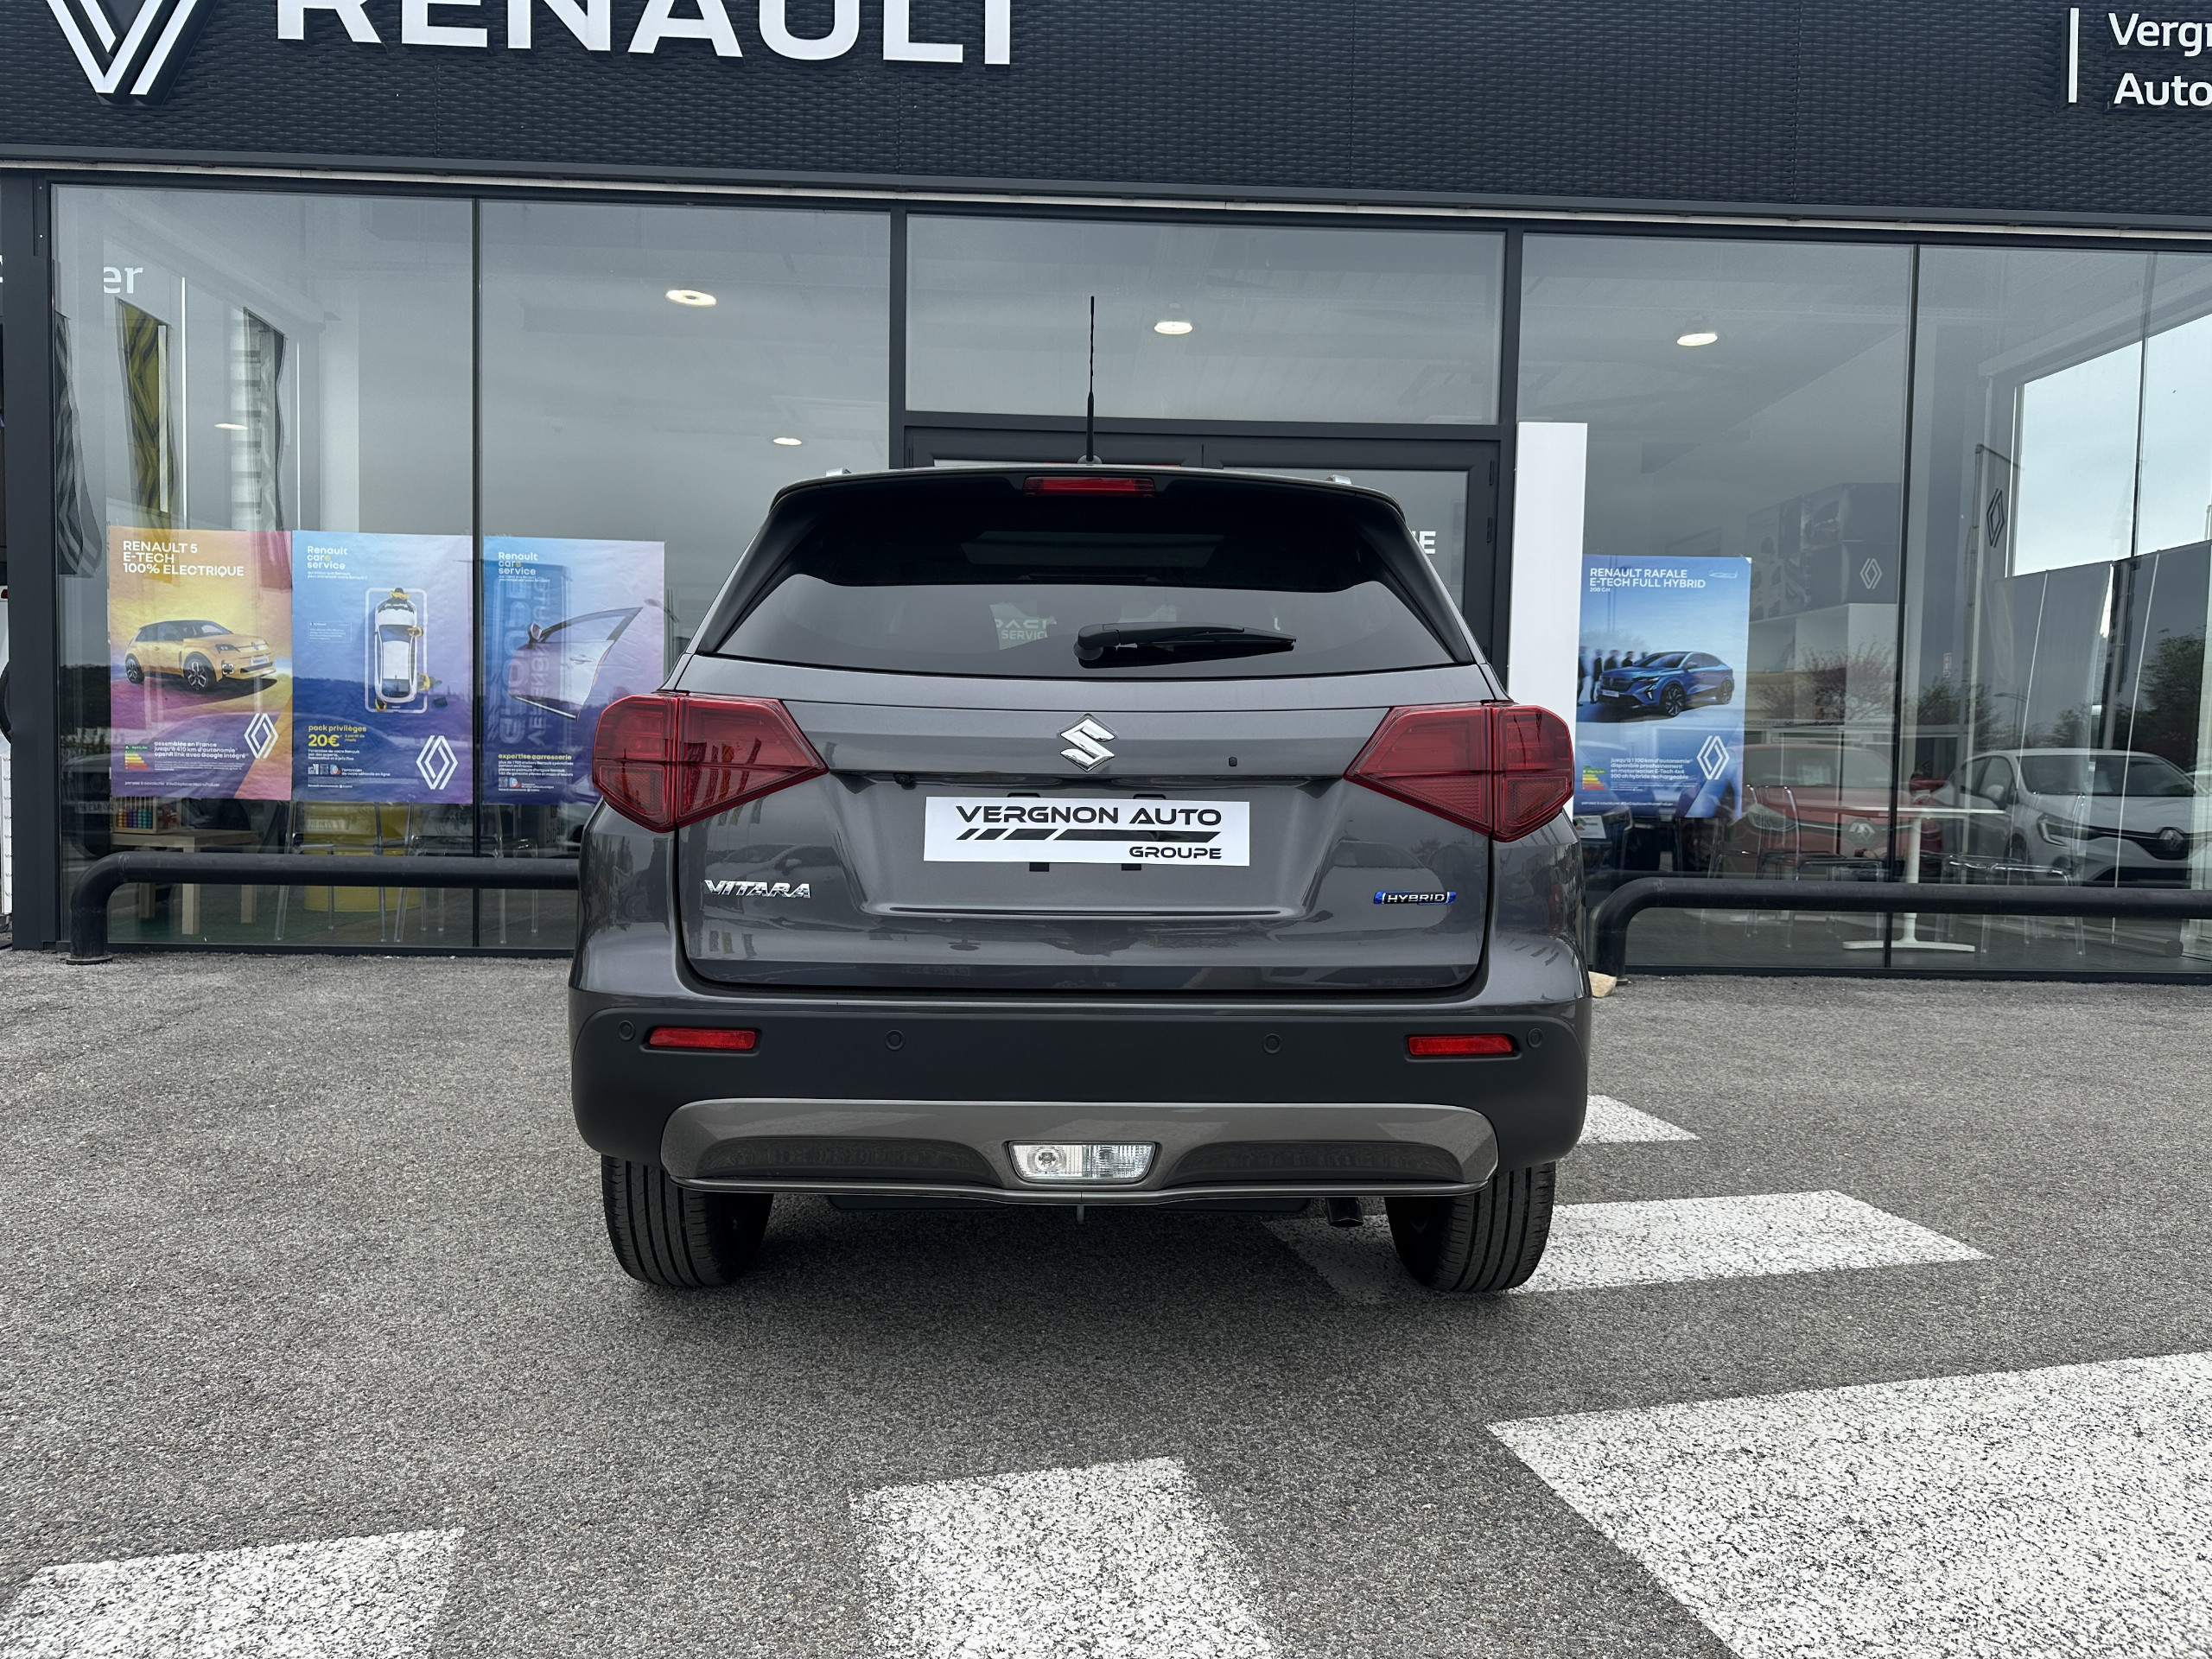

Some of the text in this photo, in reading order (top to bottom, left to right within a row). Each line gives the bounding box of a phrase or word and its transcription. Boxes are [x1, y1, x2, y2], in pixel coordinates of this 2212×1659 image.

[123, 541, 198, 553] RENAULT 5
[307, 546, 348, 555] Renault
[123, 552, 175, 563] E-TECH
[499, 551, 538, 561] Renault
[123, 563, 244, 577] 100% ELECTRIQUE
[307, 561, 346, 569] service
[499, 567, 536, 575] service
[1590, 568, 1687, 578] RENAULT RAFALE
[1590, 578, 1707, 588] E-TECH FULL HYBRID
[995, 619, 1048, 629] DACI
[1001, 630, 1047, 639] SERVIC
[956, 805, 1222, 826] VERGNON AUTO
[1128, 846, 1222, 860] GROUPE
[704, 880, 810, 899] VITARA
[1387, 893, 1446, 902] HYBRID
